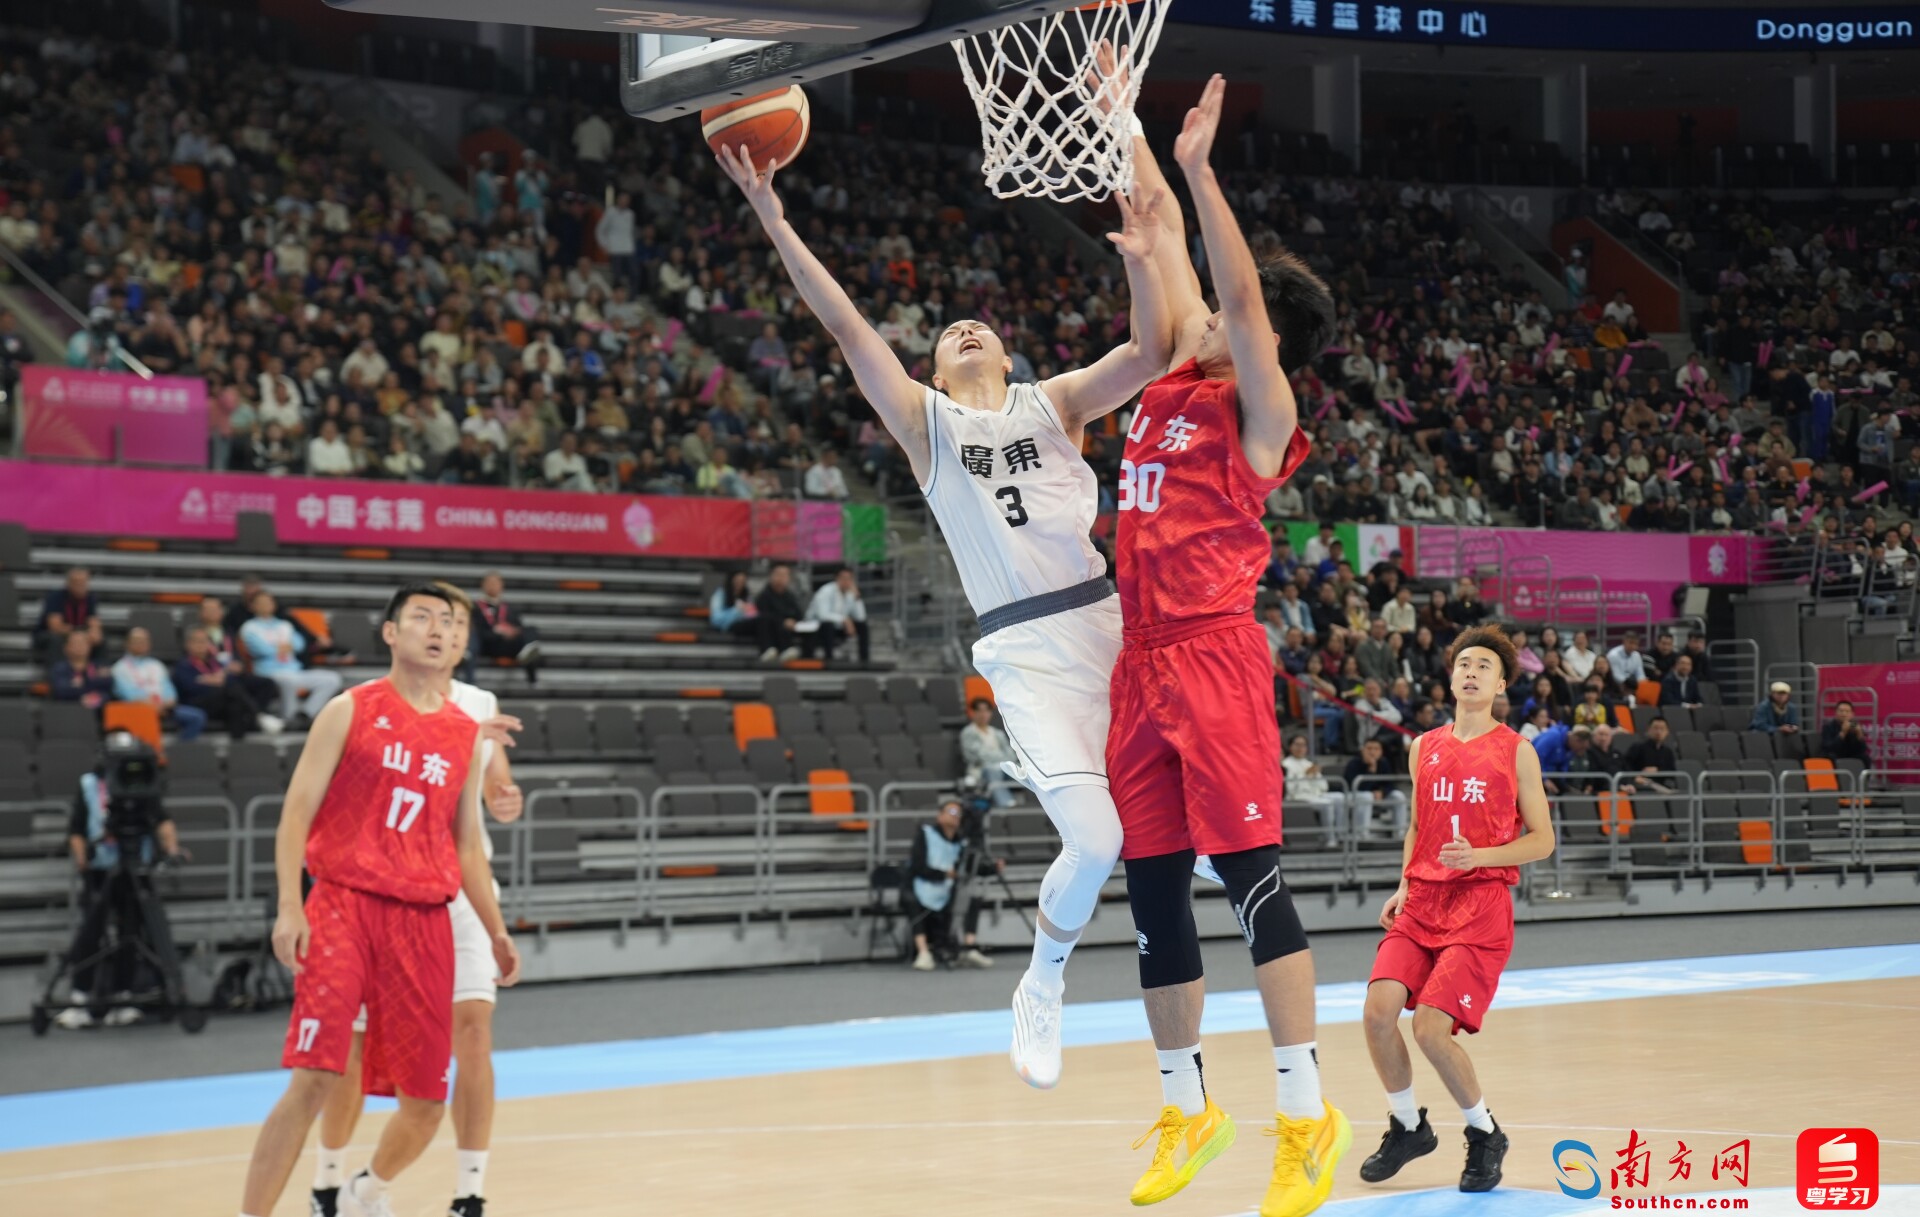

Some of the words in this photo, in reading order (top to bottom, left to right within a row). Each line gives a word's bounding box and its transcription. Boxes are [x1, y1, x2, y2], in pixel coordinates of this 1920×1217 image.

[1250, 0, 1487, 37] 东莞篮球中心
[1757, 19, 1912, 43] Dongguan
[1127, 403, 1198, 452] 山东
[961, 437, 1042, 479] 廣東
[436, 506, 497, 528] CHINA
[503, 509, 608, 533] DONGGUAN
[994, 485, 1029, 528] 3
[382, 741, 451, 787] 山东
[1433, 776, 1487, 804] 山东
[385, 786, 426, 833] 17
[1450, 814, 1460, 843] 1
[296, 1017, 320, 1053] 17
